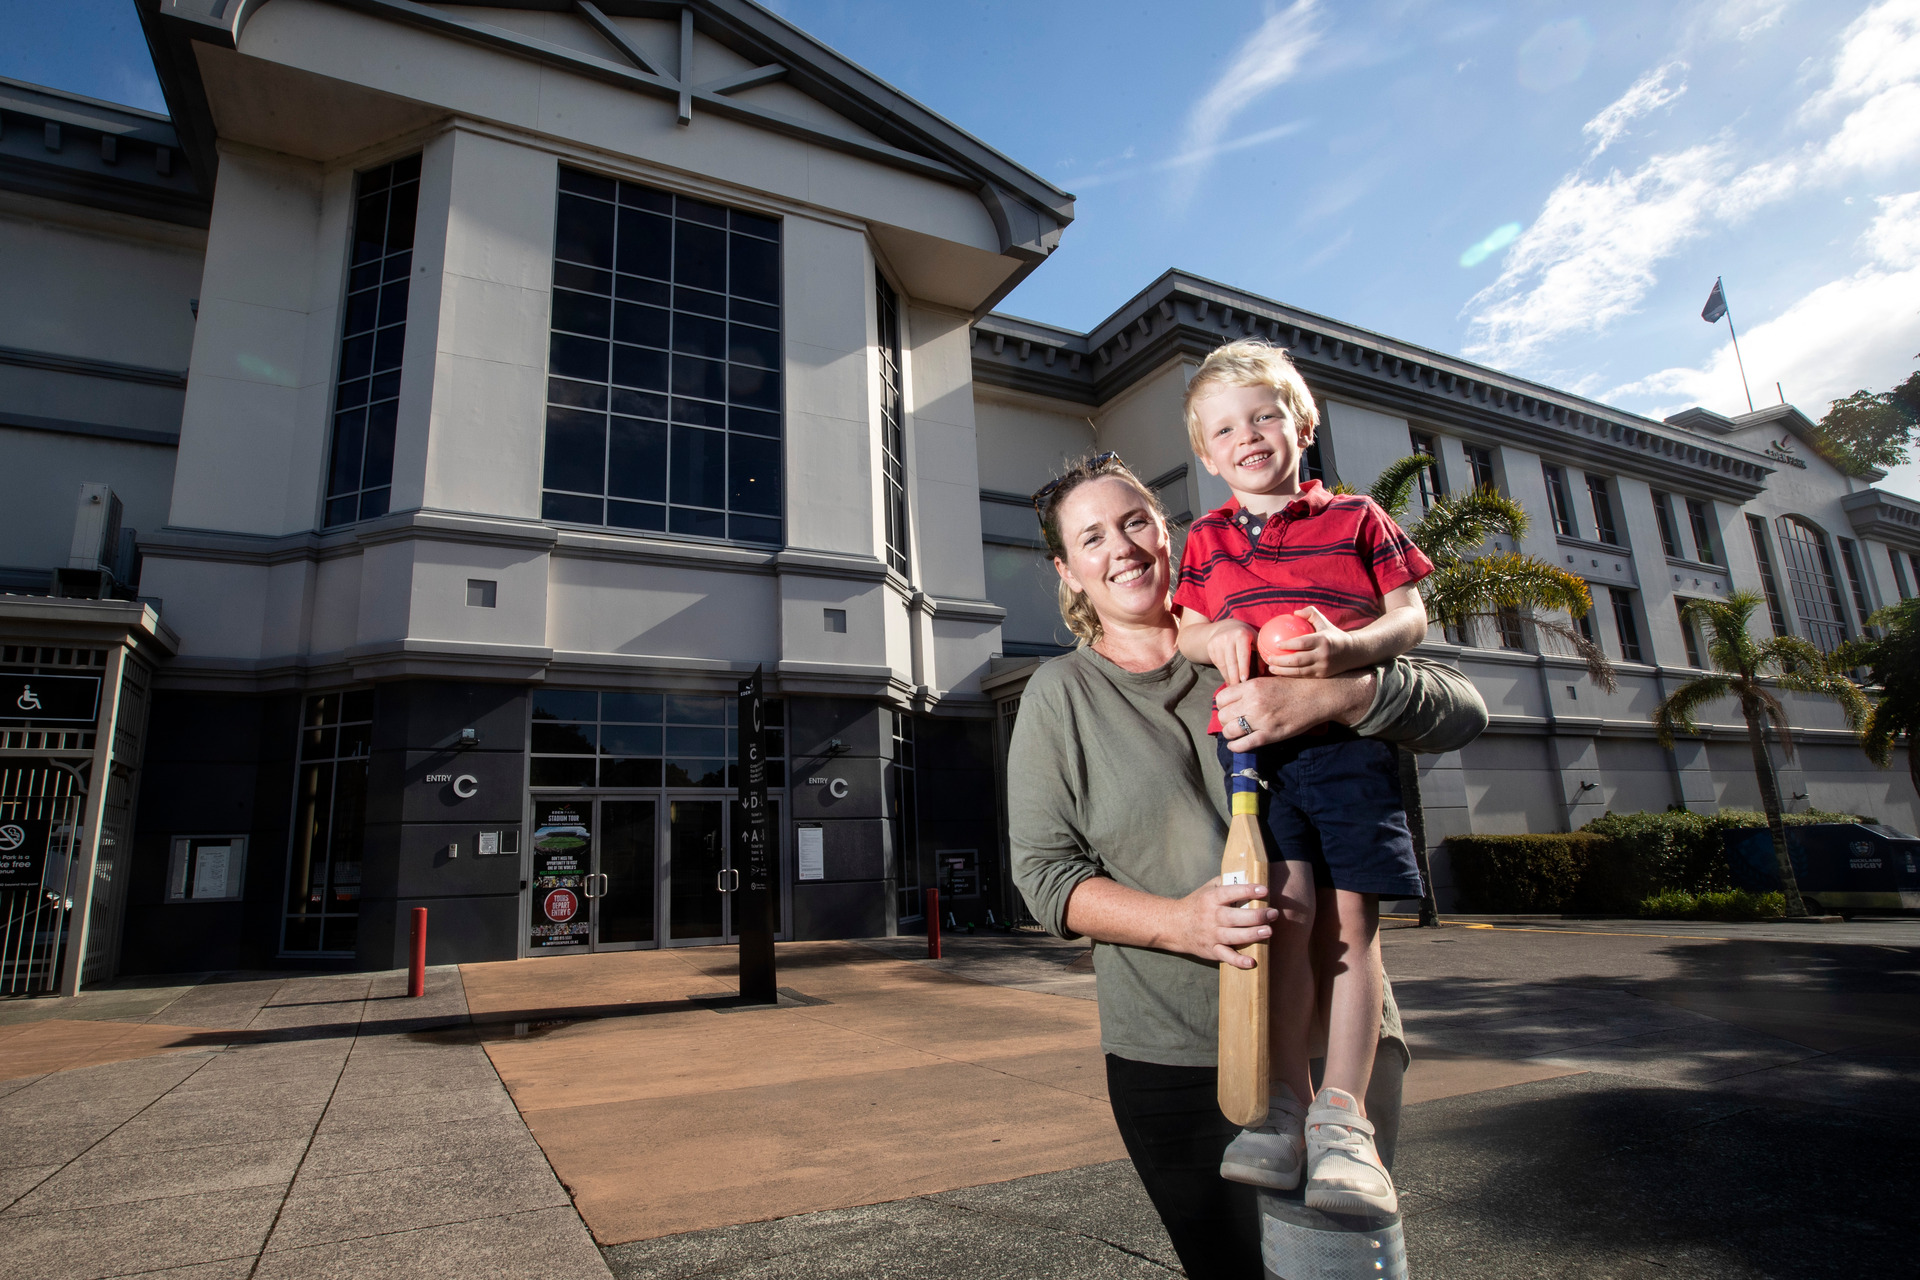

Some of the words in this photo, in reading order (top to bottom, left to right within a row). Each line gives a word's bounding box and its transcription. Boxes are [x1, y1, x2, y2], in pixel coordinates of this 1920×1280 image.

[753, 698, 760, 733] C
[750, 747, 757, 760] C
[426, 774, 452, 782] ENTRY
[453, 774, 478, 798] C
[830, 778, 848, 798] C
[12, 860, 31, 868] free
[553, 894, 569, 902] TOURS
[551, 909, 566, 917] ENTRY
[1329, 1095, 1350, 1109] NIKE
